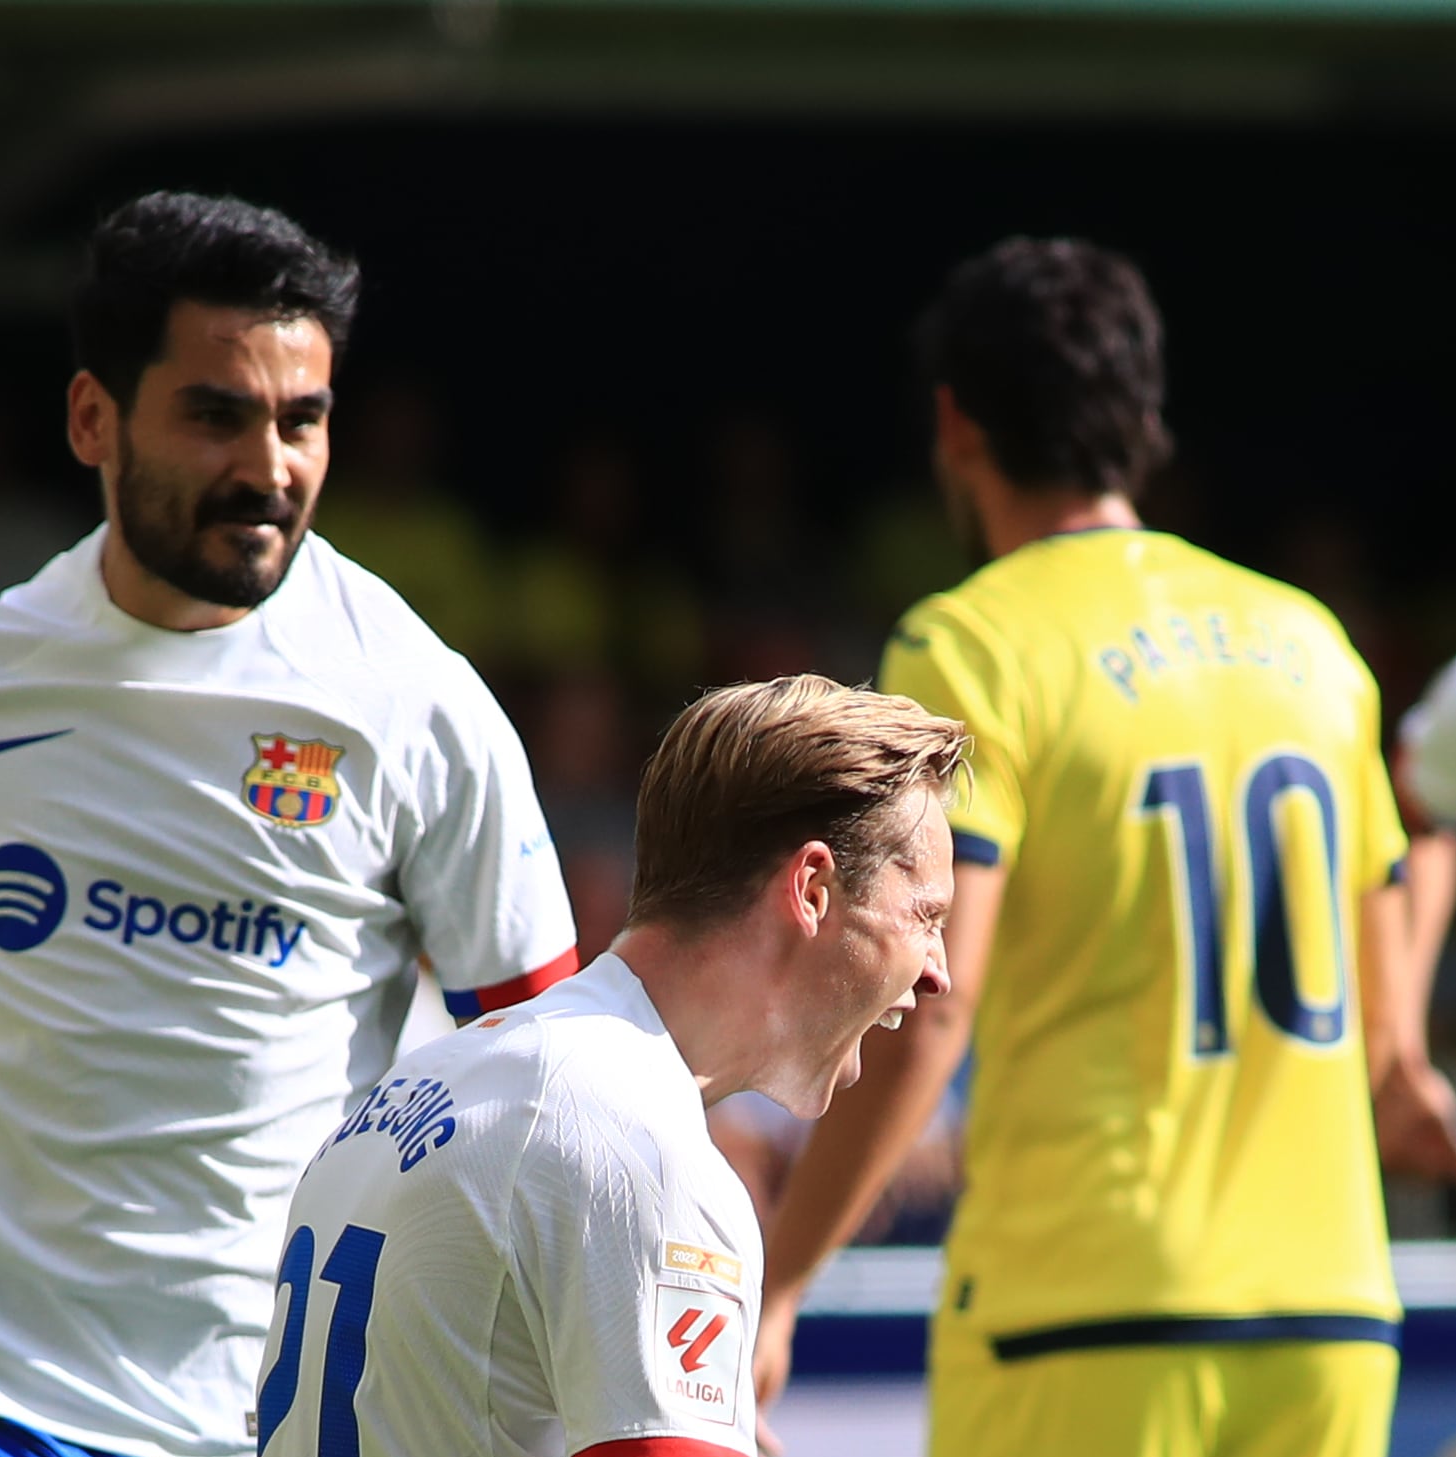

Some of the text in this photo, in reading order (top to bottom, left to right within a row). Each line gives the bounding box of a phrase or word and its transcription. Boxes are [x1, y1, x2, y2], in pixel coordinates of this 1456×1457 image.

[83, 879, 306, 968] Spotify
[1137, 752, 1347, 1062] 10
[665, 1376, 725, 1405] LALIGA
